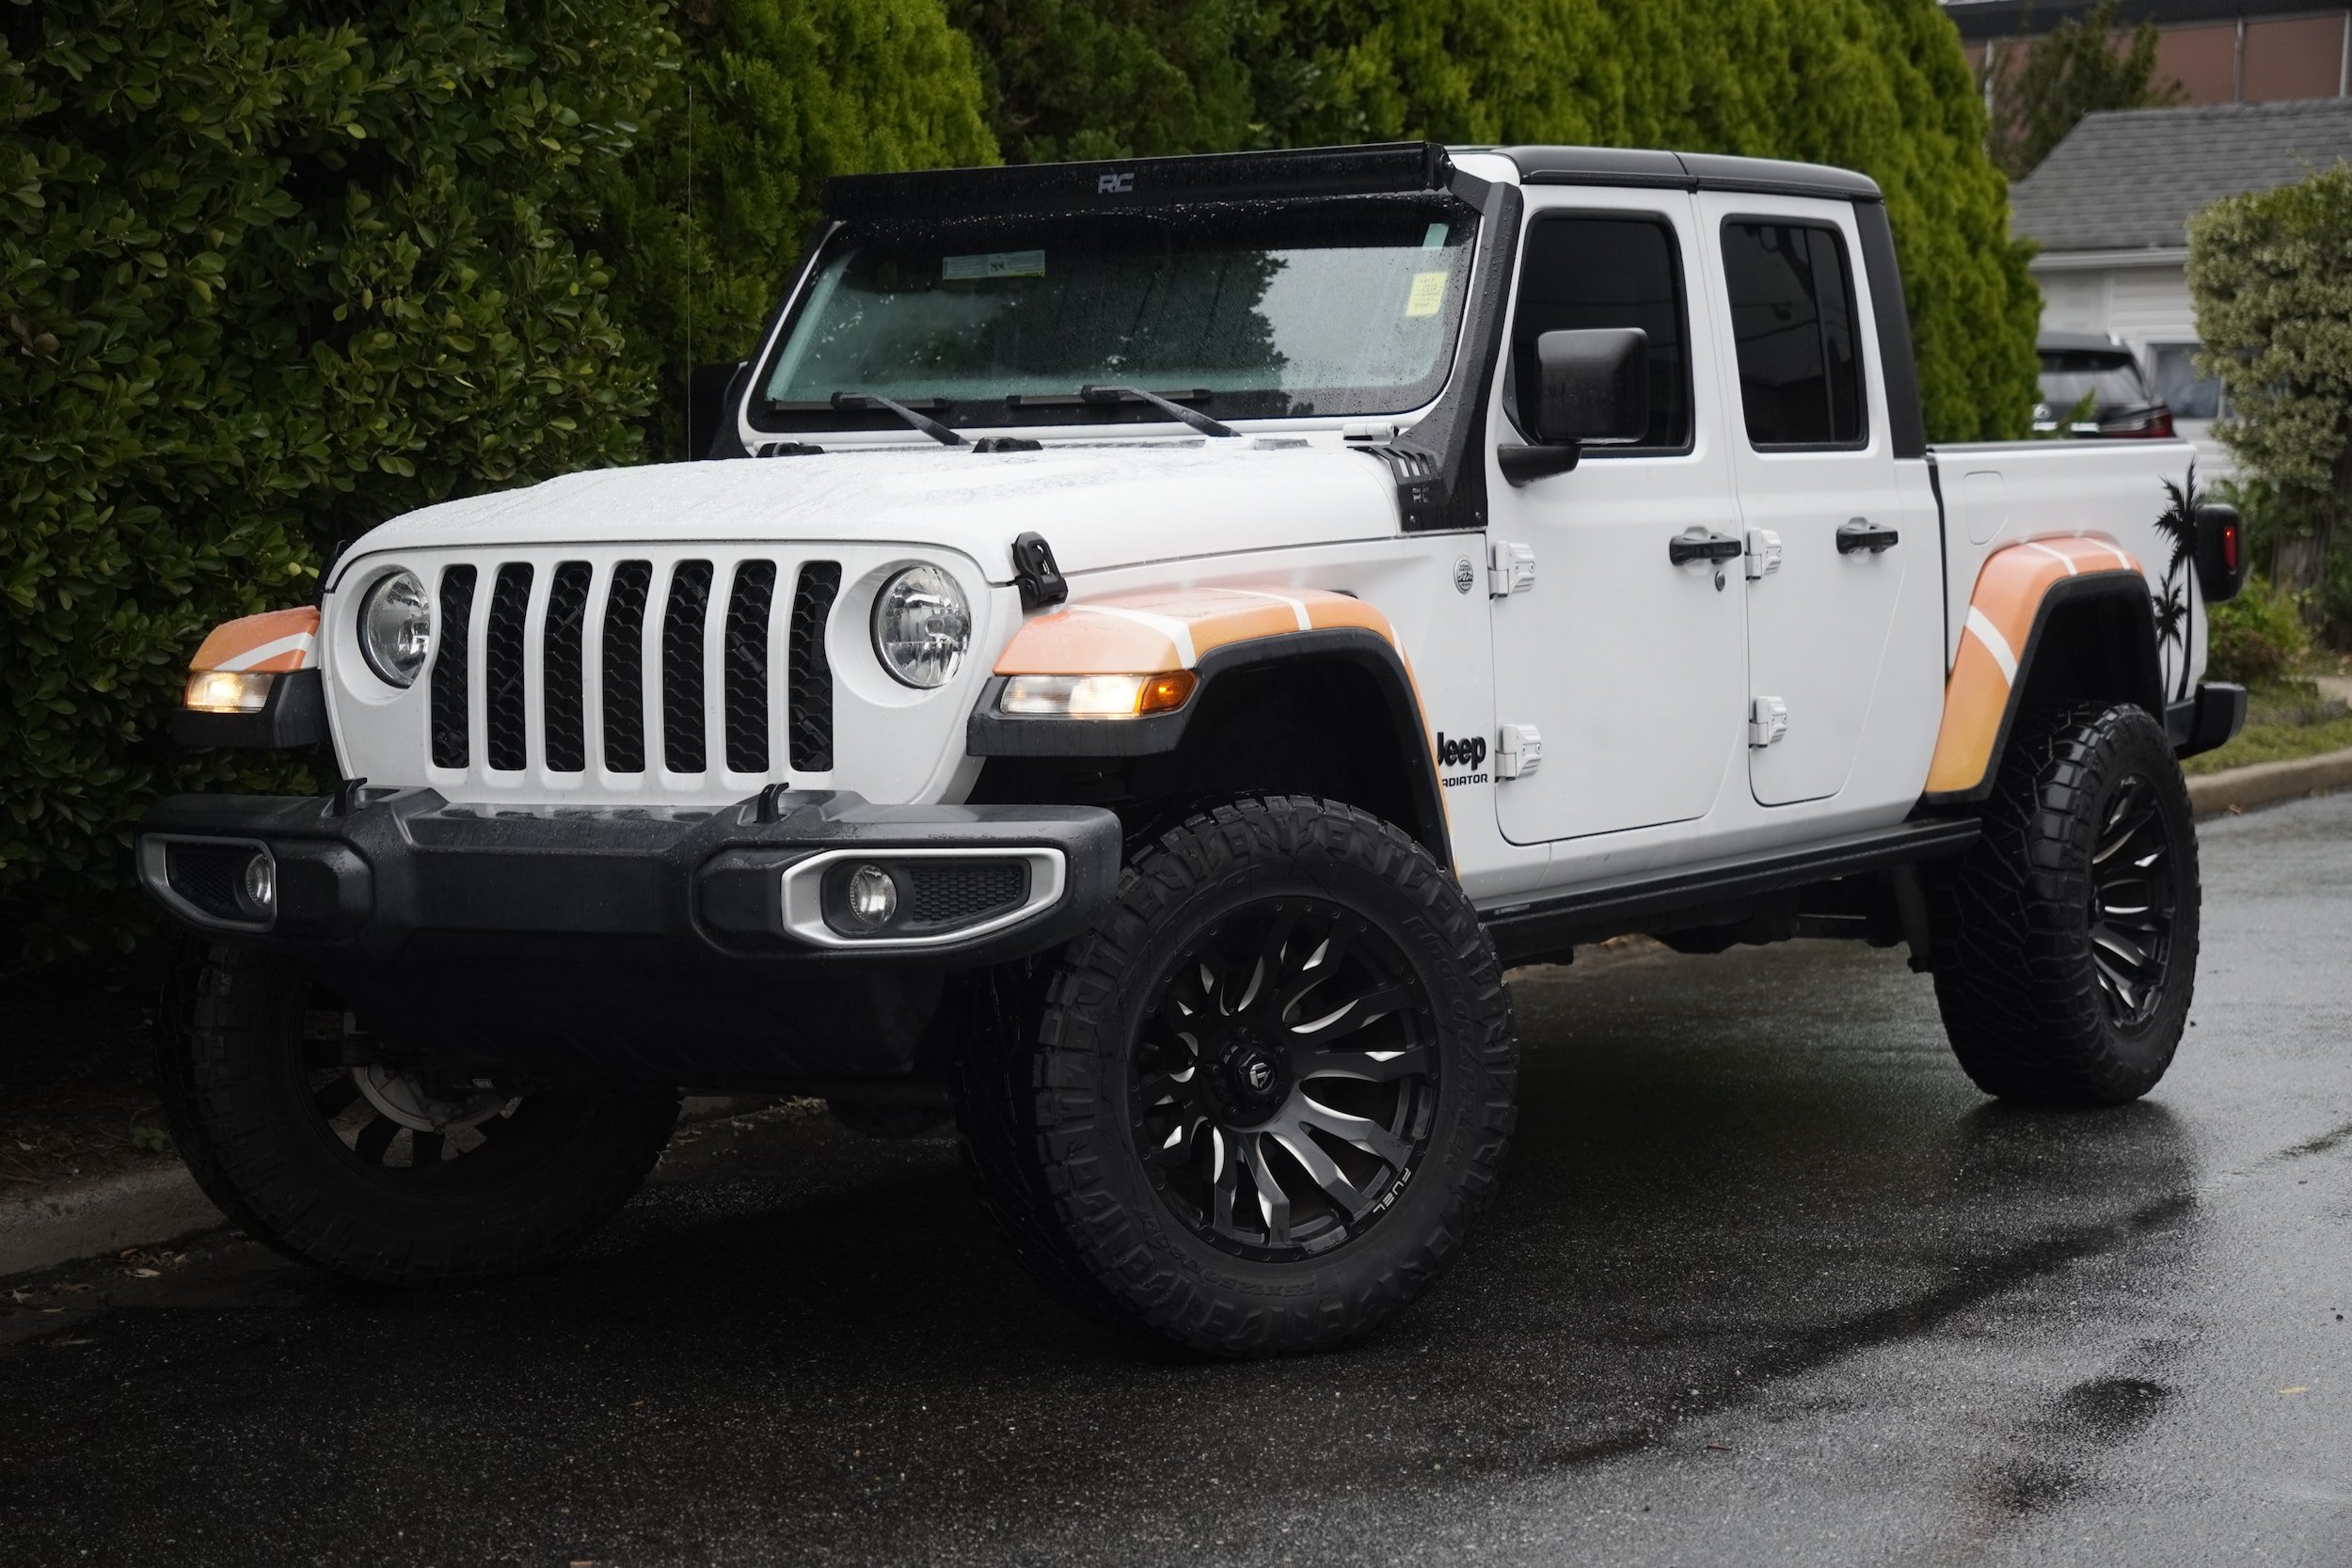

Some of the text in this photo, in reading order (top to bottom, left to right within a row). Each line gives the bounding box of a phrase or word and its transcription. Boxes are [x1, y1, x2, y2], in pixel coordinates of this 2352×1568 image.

[1098, 173, 1135, 194] RC
[1437, 731, 1486, 771] Jeep
[1441, 773, 1488, 787] ADIATOR
[1373, 1167, 1412, 1213] FUEL
